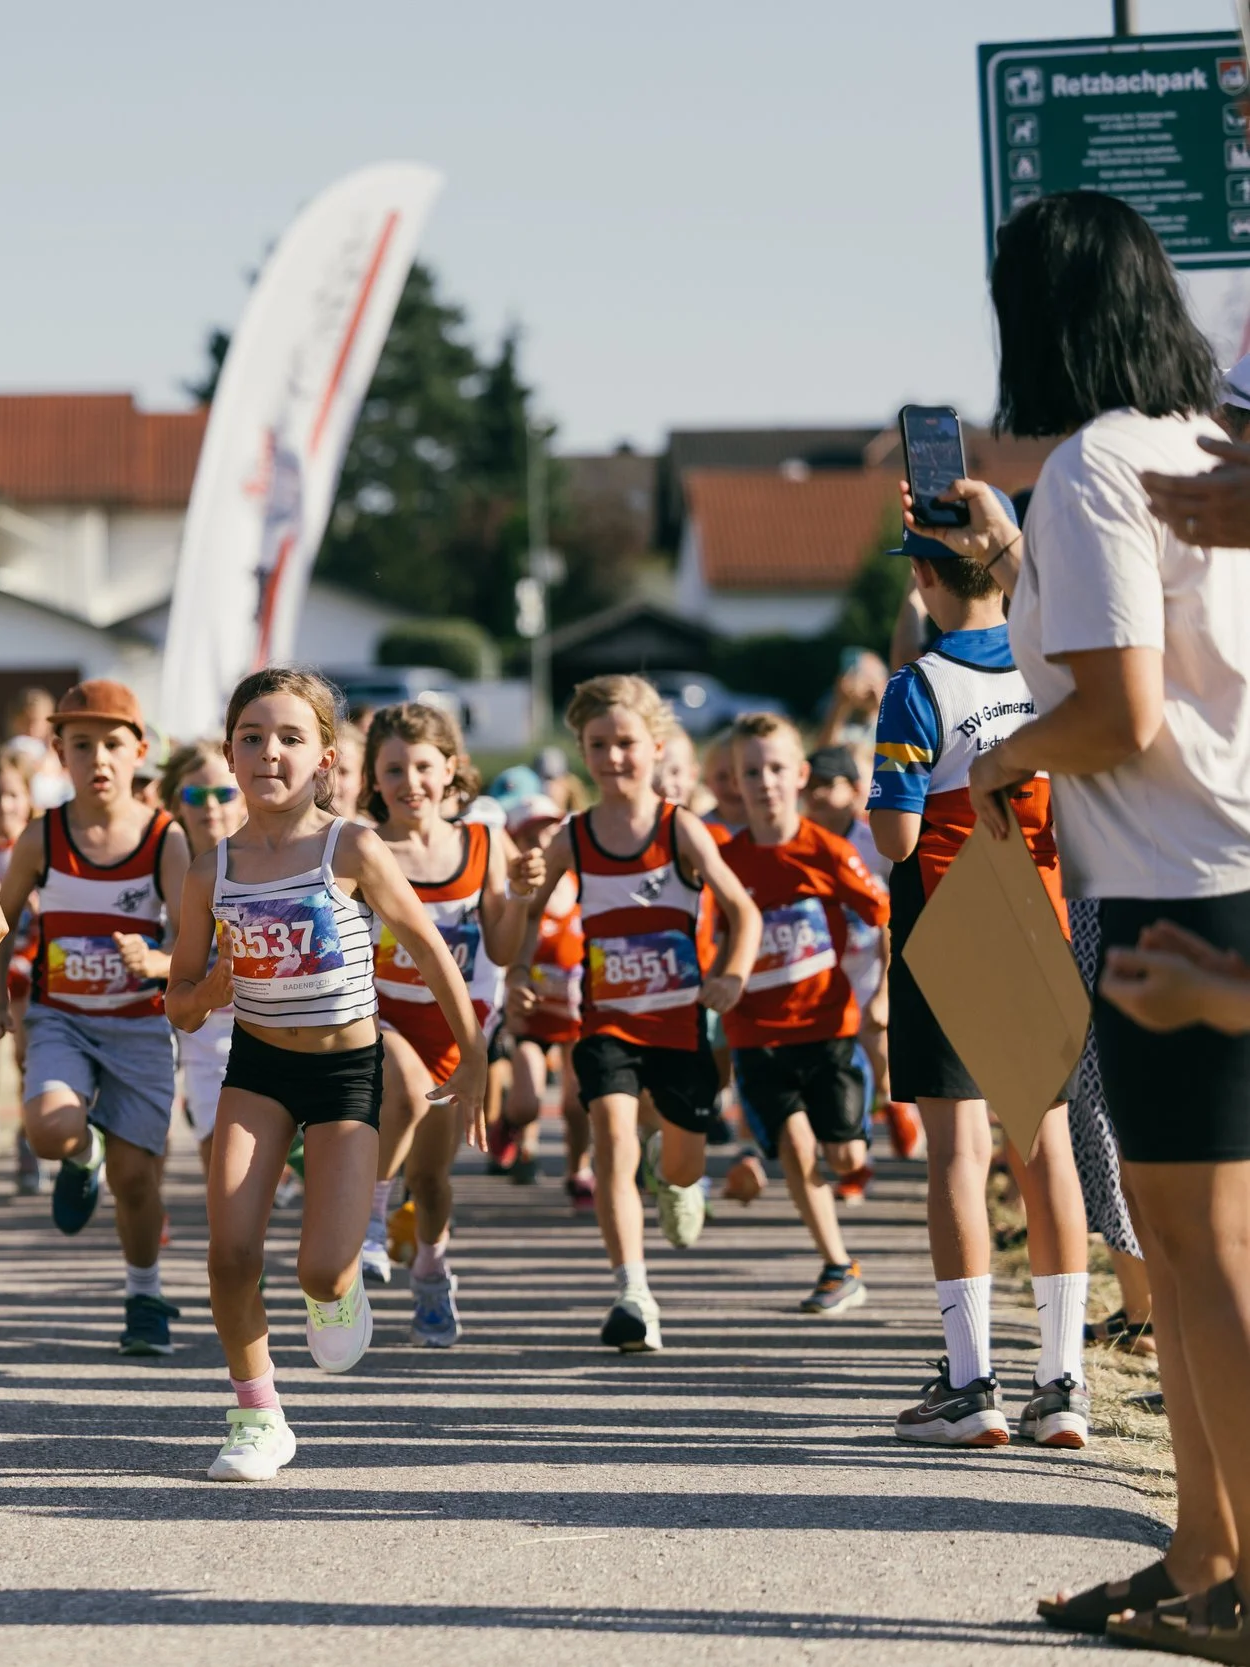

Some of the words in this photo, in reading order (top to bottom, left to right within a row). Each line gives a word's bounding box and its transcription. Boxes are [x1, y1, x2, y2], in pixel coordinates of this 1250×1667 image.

[1052, 68, 1208, 97] Retzbachpark
[231, 920, 315, 960] 8537
[604, 949, 678, 985] 8551
